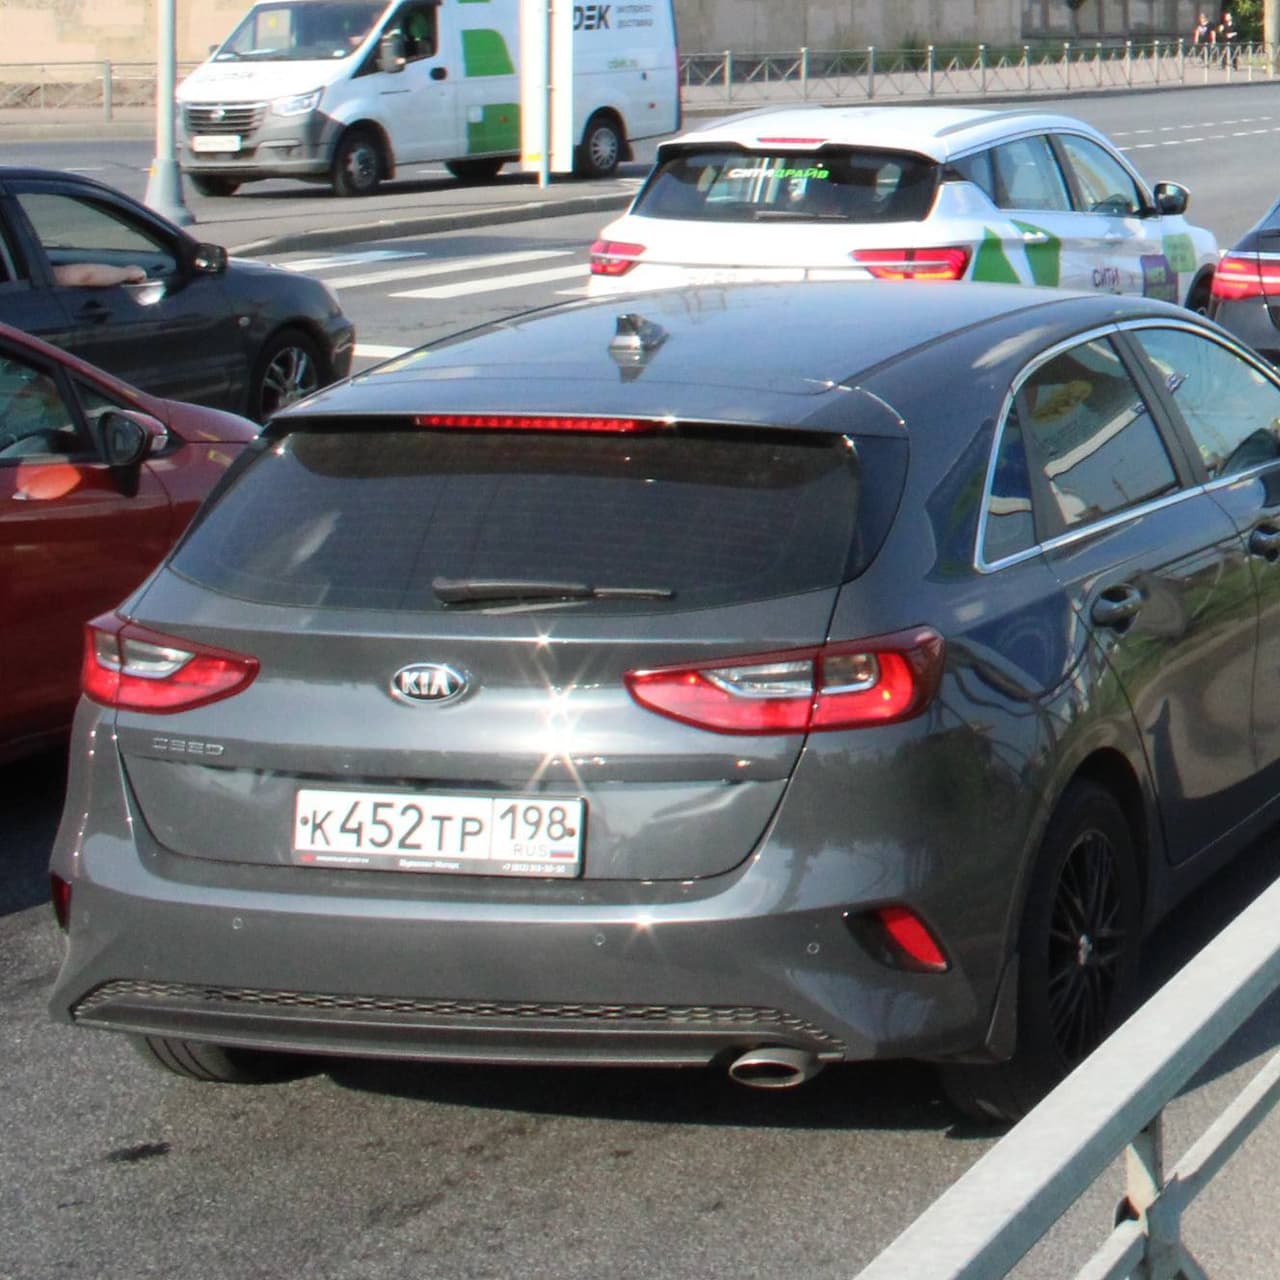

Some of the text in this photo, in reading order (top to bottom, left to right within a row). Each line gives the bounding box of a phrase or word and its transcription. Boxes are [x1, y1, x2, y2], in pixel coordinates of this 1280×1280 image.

[573, 5, 611, 31] DEK
[401, 671, 451, 696] KIA
[500, 804, 567, 841] 198
[513, 843, 548, 857] RUS
